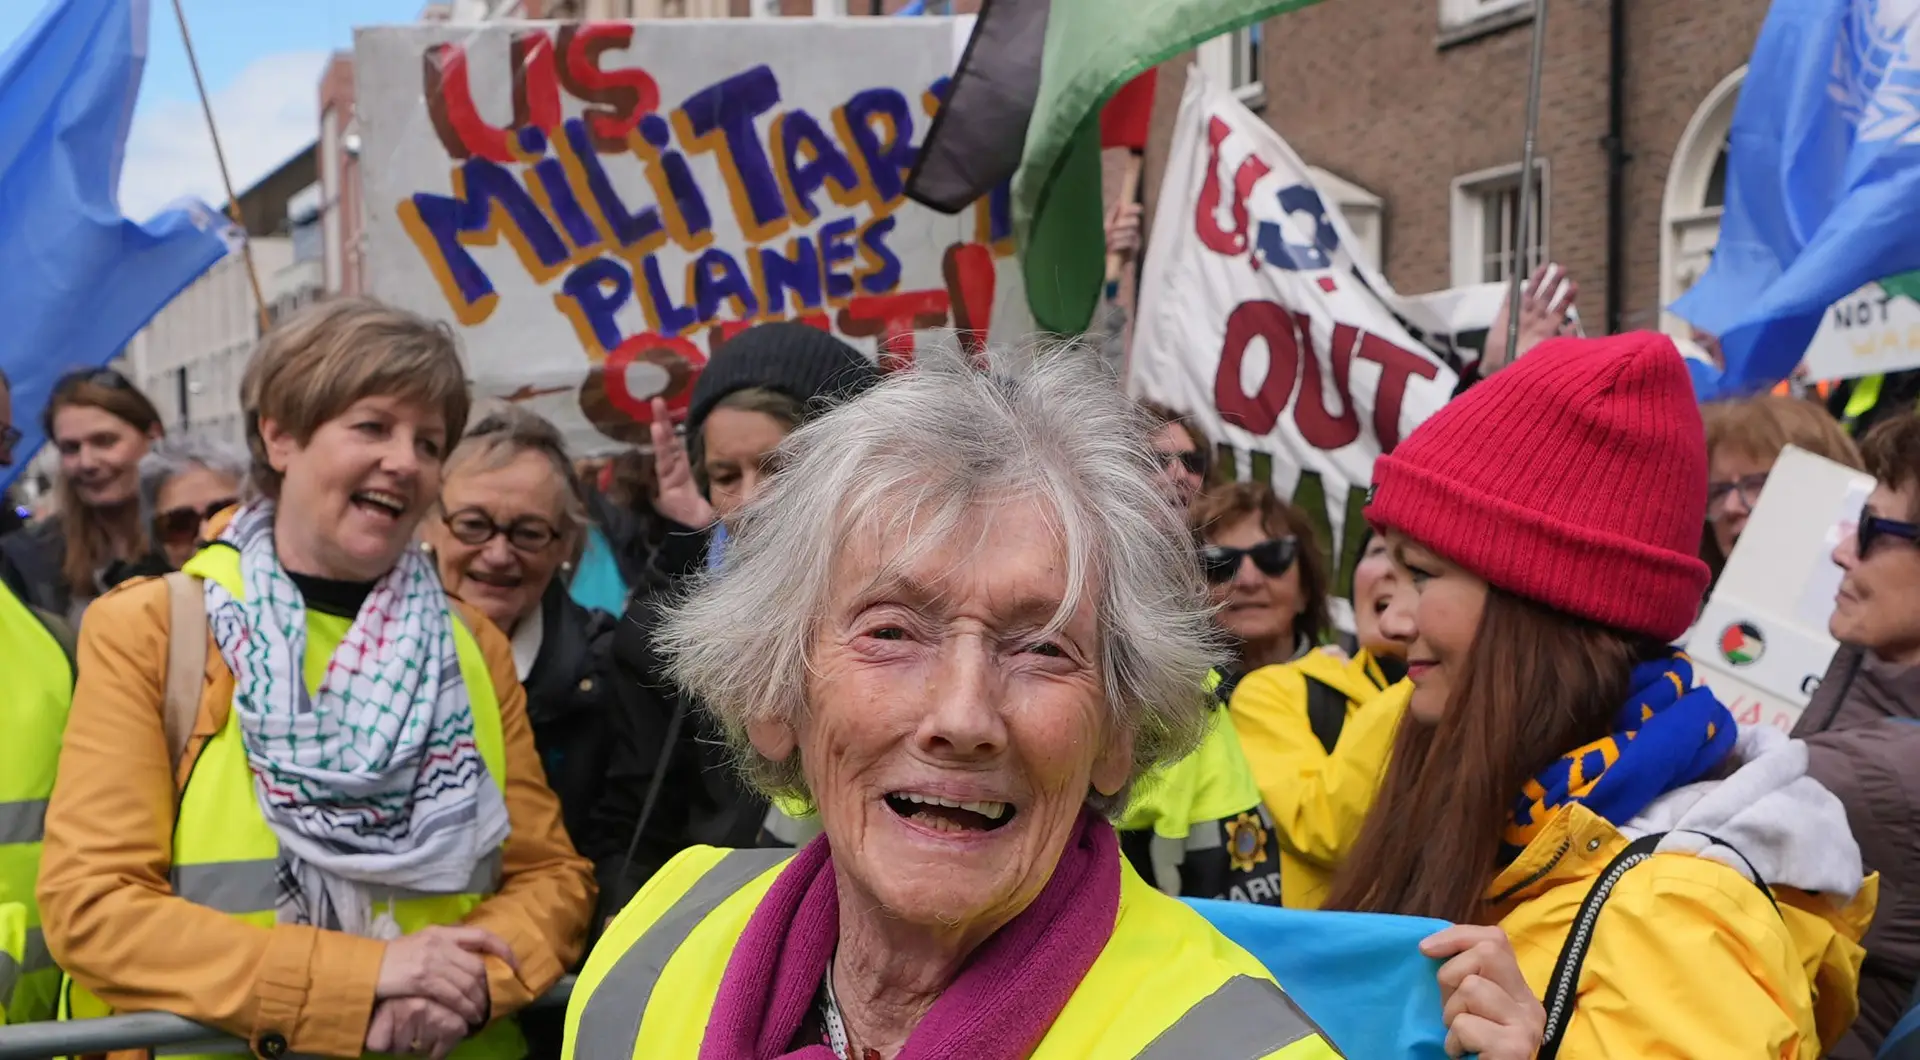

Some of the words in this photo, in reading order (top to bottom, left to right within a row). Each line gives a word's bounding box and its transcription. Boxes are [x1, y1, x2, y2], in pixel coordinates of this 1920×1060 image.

[423, 22, 661, 163] US
[554, 216, 900, 360] PLANES
[579, 242, 996, 443] OT!
[1833, 297, 1892, 329] NOT
[1215, 299, 1438, 455] OUT
